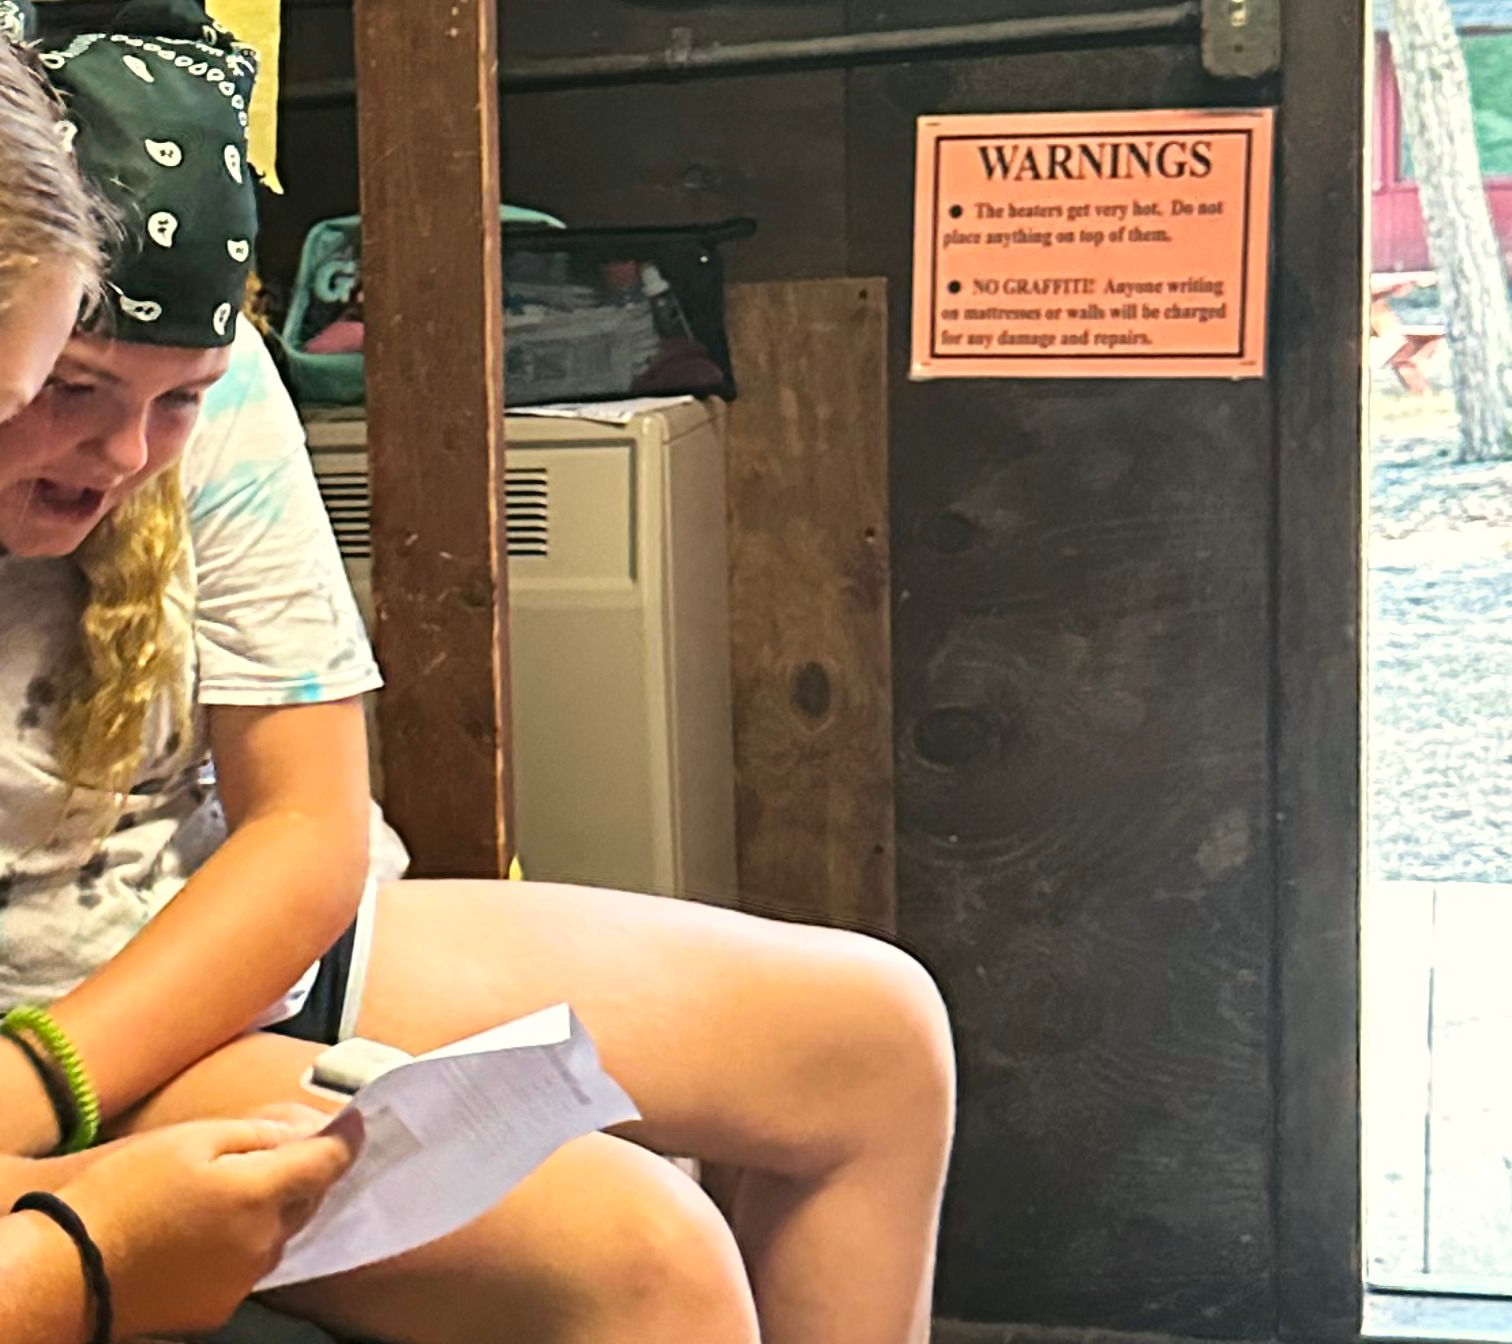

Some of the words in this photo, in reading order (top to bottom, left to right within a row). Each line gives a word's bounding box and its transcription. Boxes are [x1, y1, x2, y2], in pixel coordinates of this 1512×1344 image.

[978, 140, 1213, 182] WARNINGS
[975, 201, 1003, 218] The
[1008, 202, 1062, 218] heaters
[1066, 203, 1091, 221] get
[1094, 205, 1128, 221] very
[1133, 200, 1164, 217] hot.
[1171, 199, 1194, 216] Do
[1197, 200, 1224, 216] not
[943, 230, 981, 247] place
[985, 228, 1052, 247] anything
[1056, 231, 1075, 244] on
[1079, 229, 1104, 247] top
[1109, 227, 1126, 243] of
[1128, 226, 1173, 243] them.
[972, 279, 999, 296] NO
[1104, 279, 1163, 298] Anyone
[1167, 278, 1224, 297] writing
[941, 306, 960, 320] on
[964, 304, 1041, 320] mattresses
[1044, 305, 1063, 320] or
[1066, 304, 1107, 320] walls
[1110, 303, 1138, 320] will
[1142, 302, 1160, 320] be
[1164, 302, 1227, 323] charged
[941, 329, 963, 346] for
[967, 331, 993, 349] any
[998, 329, 1056, 348] damage
[1060, 329, 1089, 346] and
[1093, 330, 1153, 349] repairs.
